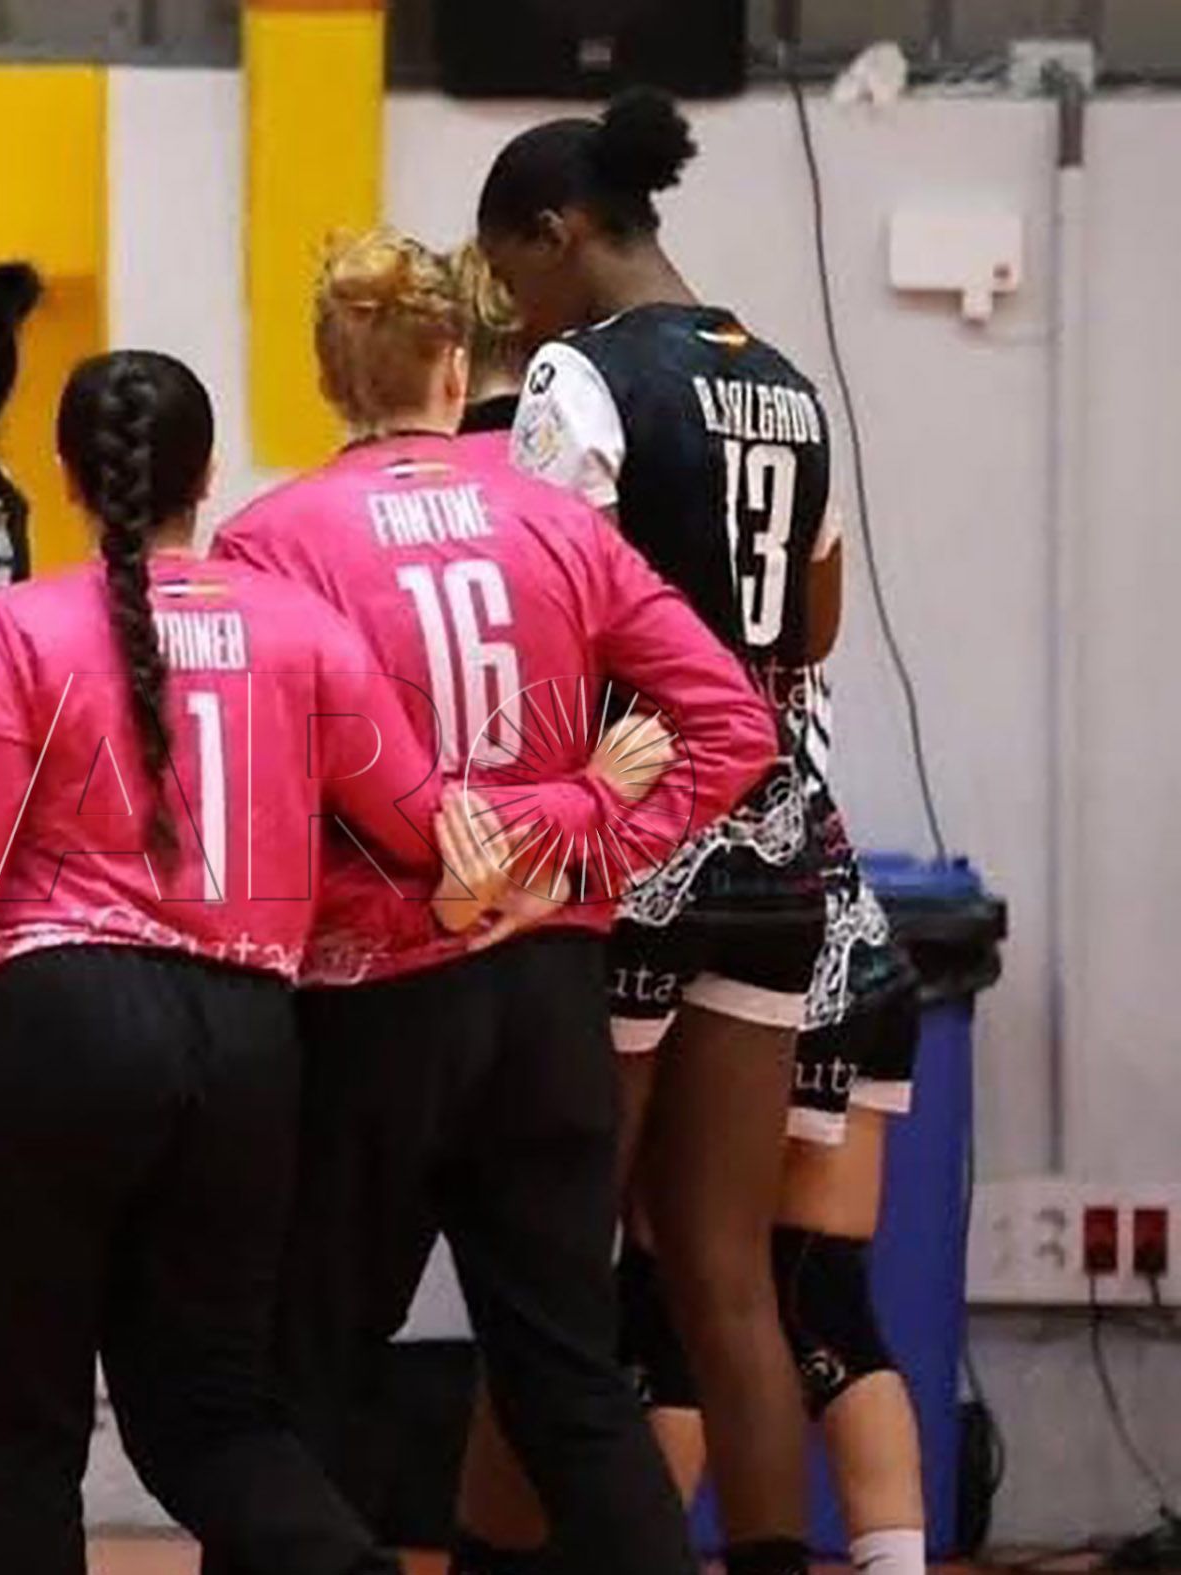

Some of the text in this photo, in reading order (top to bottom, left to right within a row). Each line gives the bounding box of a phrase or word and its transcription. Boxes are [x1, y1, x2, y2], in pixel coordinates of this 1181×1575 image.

[366, 483, 494, 548] FANTINE
[724, 440, 797, 646] 13
[396, 559, 521, 773] 16
[187, 691, 225, 902] 1
